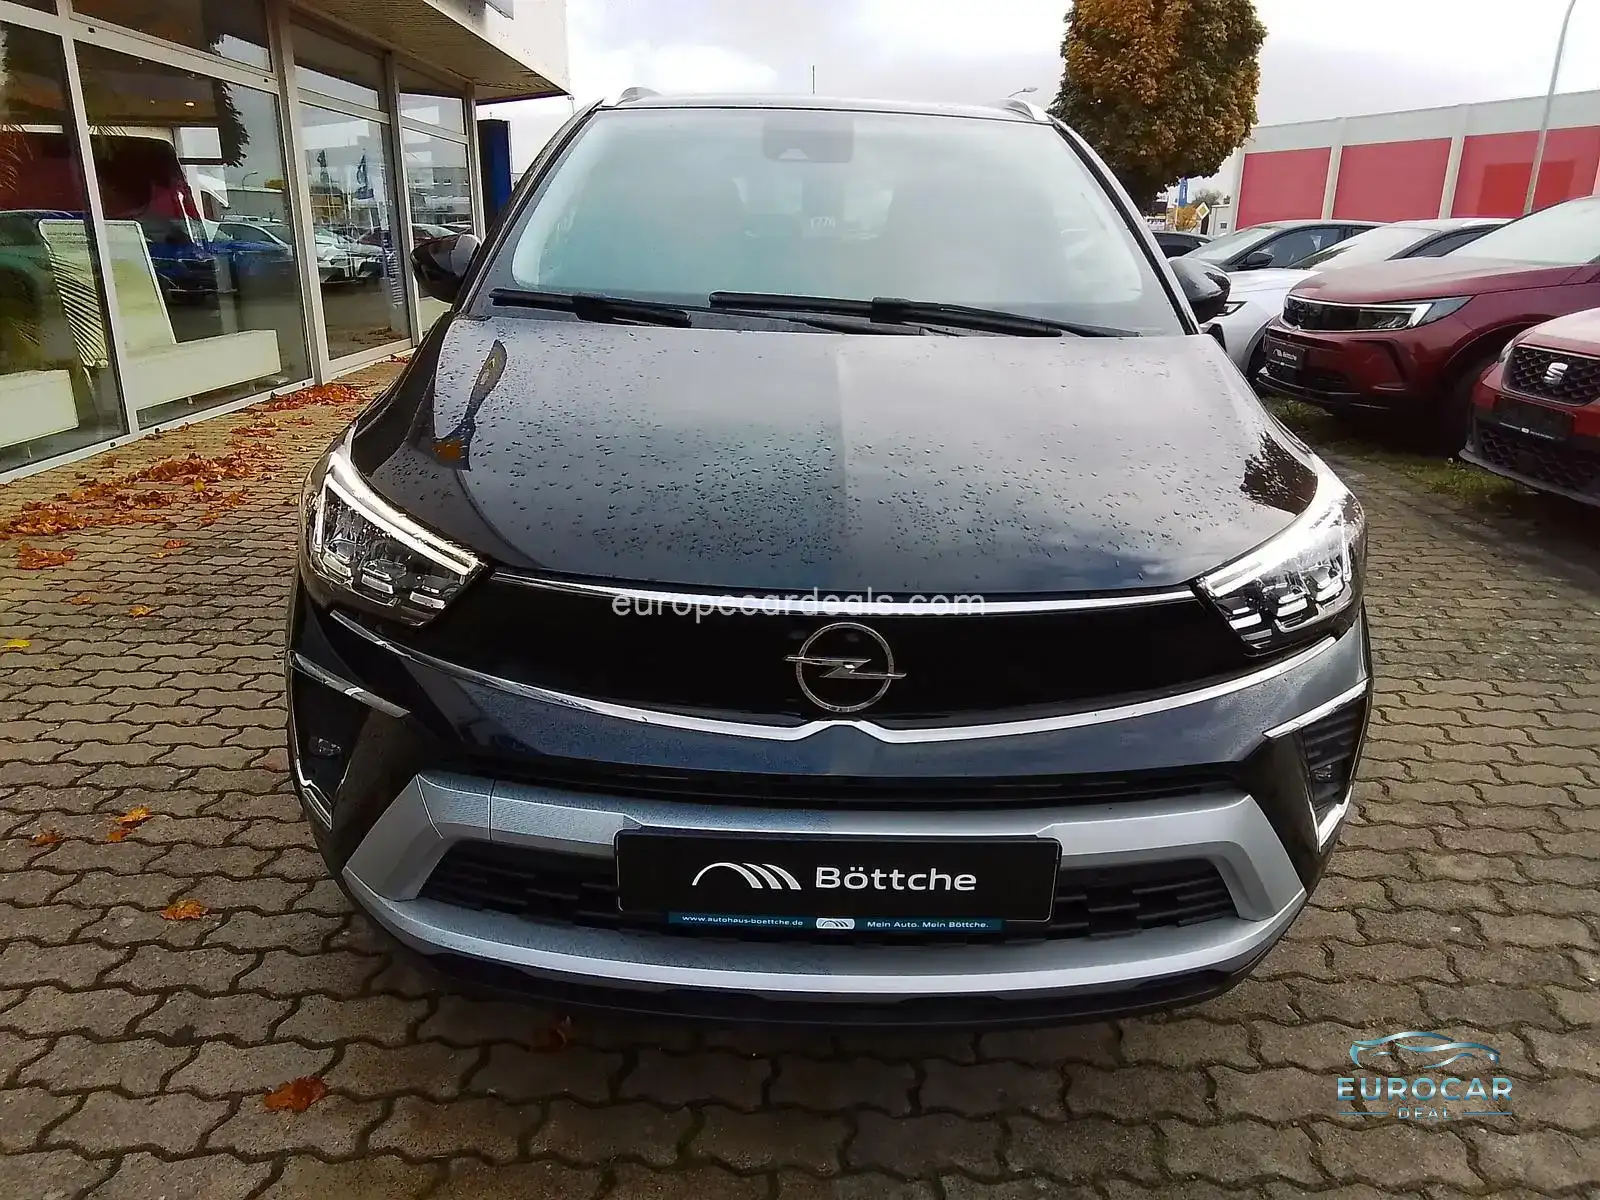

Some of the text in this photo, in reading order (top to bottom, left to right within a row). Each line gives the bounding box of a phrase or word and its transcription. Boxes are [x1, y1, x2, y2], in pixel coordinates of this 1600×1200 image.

[815, 866, 977, 891] Böttche
[681, 914, 989, 928] www.autohaus-boettche.de Mein Auto. Mein Böttche.
